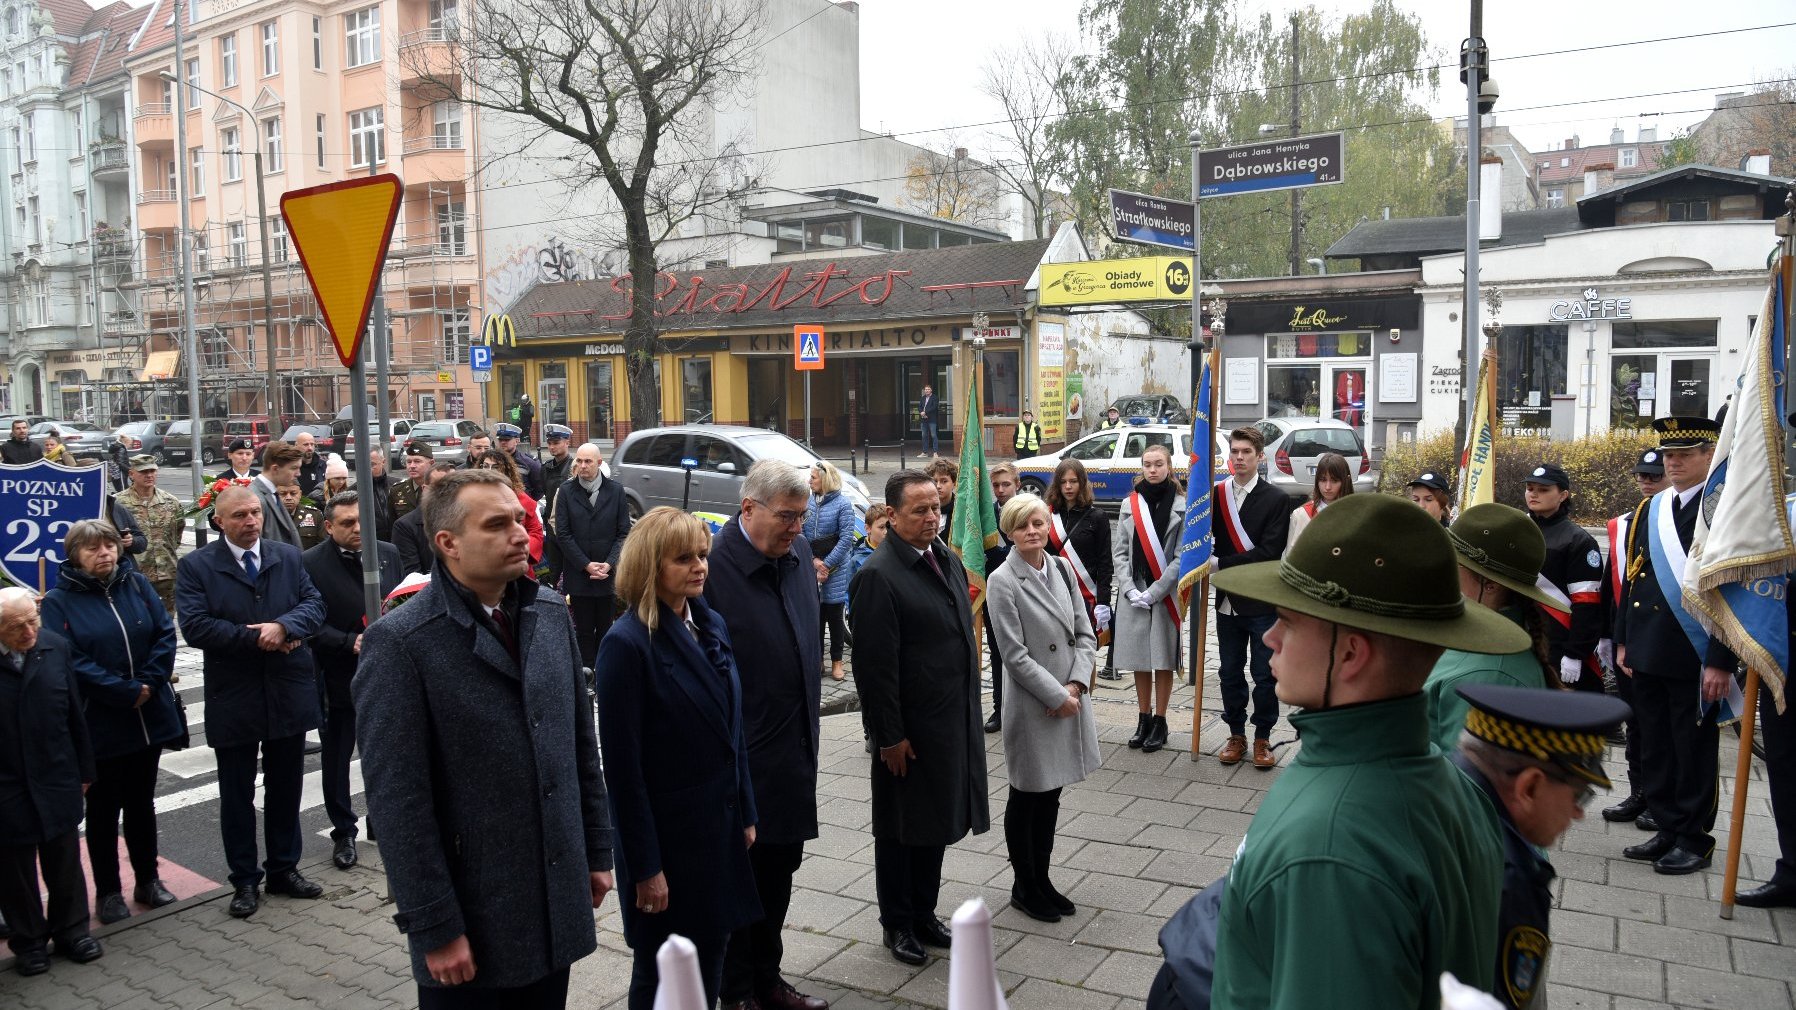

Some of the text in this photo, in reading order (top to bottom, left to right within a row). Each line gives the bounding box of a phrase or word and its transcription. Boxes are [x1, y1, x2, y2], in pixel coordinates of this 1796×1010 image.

[1228, 142, 1310, 159] ulica Jana Henryka
[1214, 156, 1329, 182] Dąbrowskiego
[1115, 206, 1191, 236] Strzałkowskiego
[1105, 270, 1142, 281] Obiady
[1110, 280, 1154, 290] domowe
[1167, 268, 1184, 286] 16
[601, 262, 913, 321] Rialto
[1550, 298, 1632, 320] CAFFE
[585, 343, 626, 356] McDon
[750, 334, 790, 351] KIN
[474, 348, 488, 368] P
[1, 478, 85, 497] POZNAŃ
[26, 498, 59, 517] SP
[4, 519, 75, 564] 23
